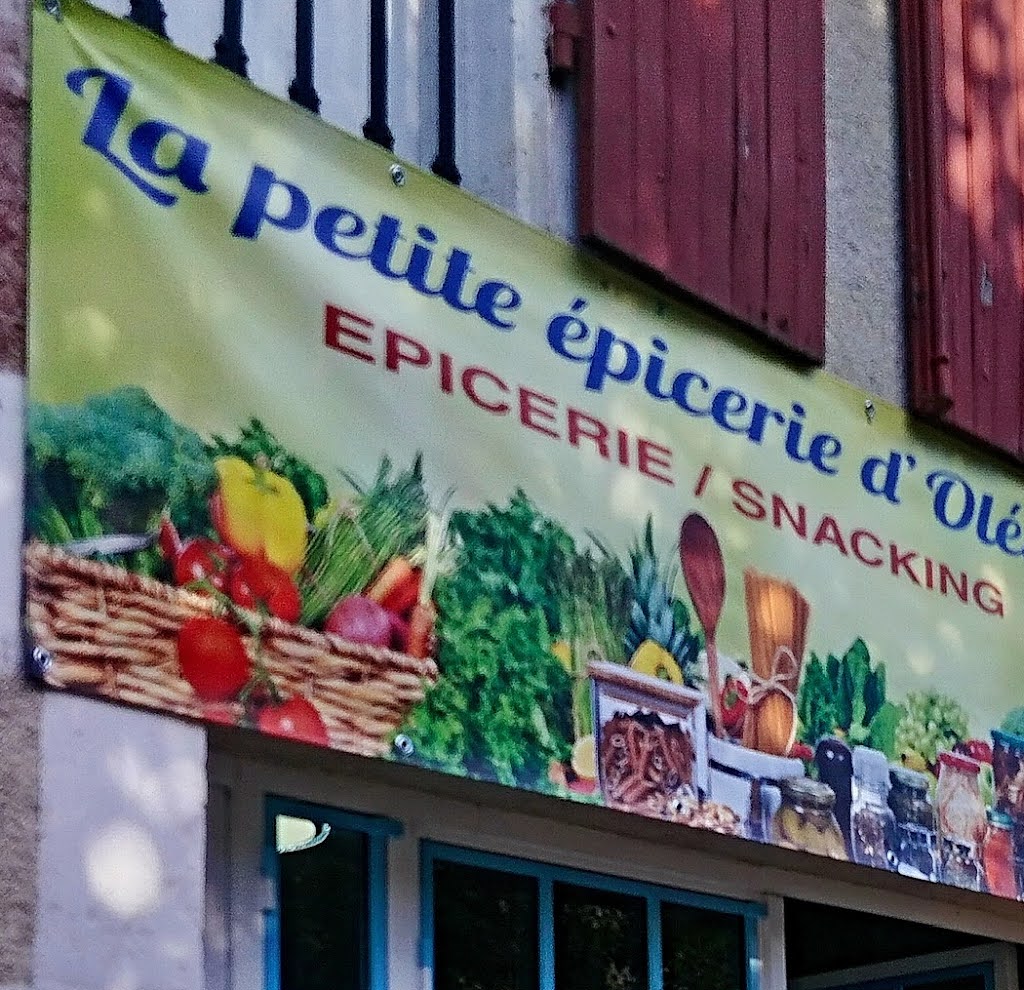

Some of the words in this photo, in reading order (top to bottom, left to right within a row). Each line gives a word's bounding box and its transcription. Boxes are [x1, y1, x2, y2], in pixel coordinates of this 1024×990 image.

[66, 67, 211, 206] La
[230, 163, 522, 331] petite
[546, 298, 841, 476] épicerie
[323, 304, 675, 486] EPICERIE
[732, 478, 1006, 617] SNACKING
